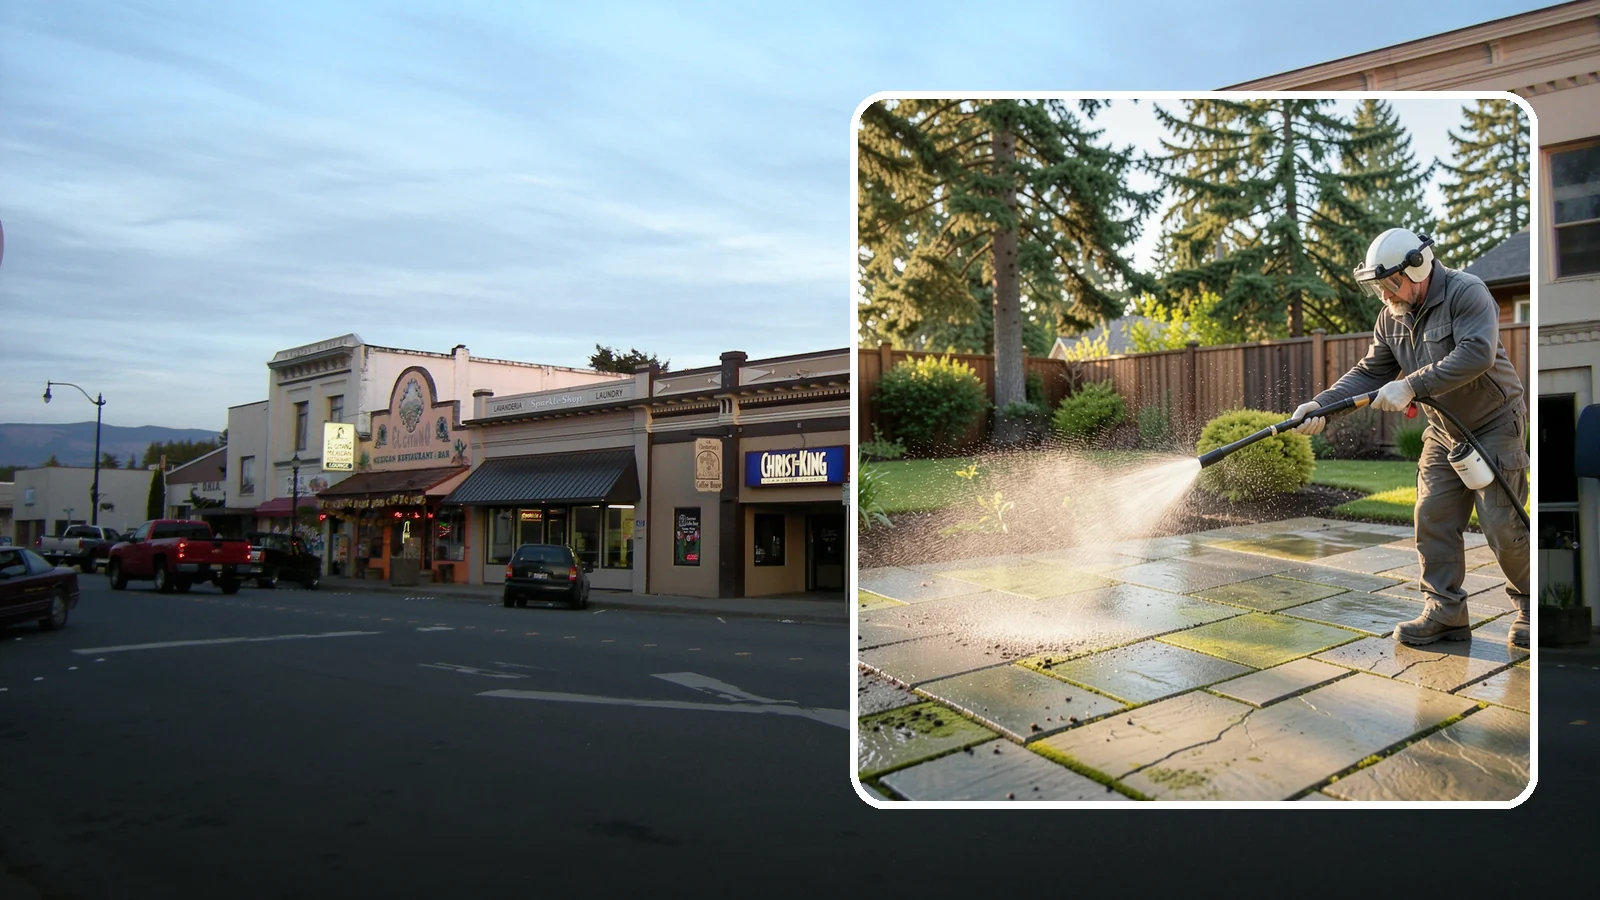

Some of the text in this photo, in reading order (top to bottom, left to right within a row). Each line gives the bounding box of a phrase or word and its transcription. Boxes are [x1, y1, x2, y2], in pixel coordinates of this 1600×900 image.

[595, 389, 623, 400] LAUNDRY
[493, 402, 522, 412] LAVANDERIA
[531, 394, 582, 408] Sparkle Shop
[373, 454, 396, 464] MEXICAN
[398, 452, 433, 462] RESTAURANT
[438, 450, 450, 459] BAR
[761, 450, 827, 478] CHRIST KING
[696, 480, 722, 488] Coffee House
